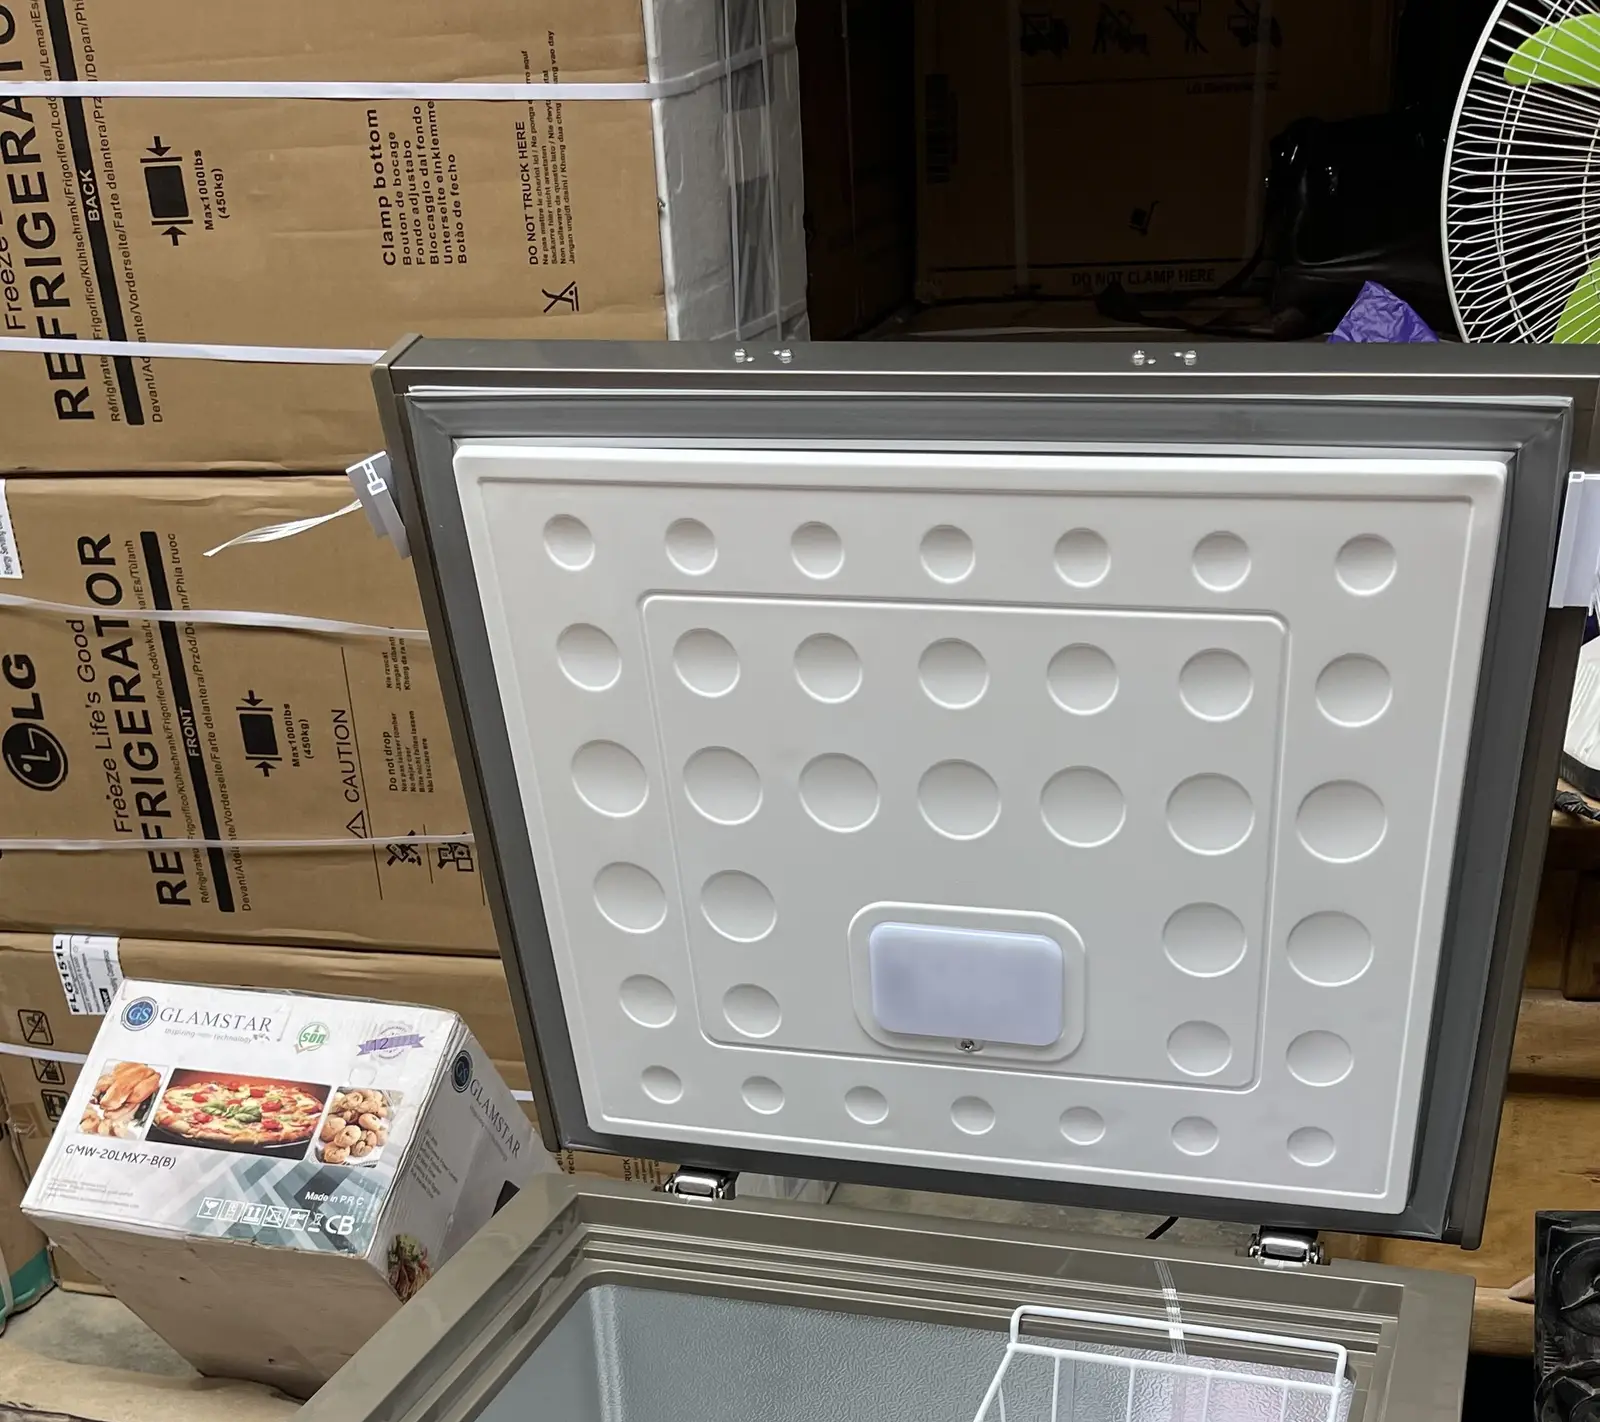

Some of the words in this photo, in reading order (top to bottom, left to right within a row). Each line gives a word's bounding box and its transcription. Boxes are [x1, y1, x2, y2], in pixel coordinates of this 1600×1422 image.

[366, 109, 387, 189] bottom
[411, 105, 425, 150] fondo
[515, 121, 529, 159] HERE
[387, 131, 402, 187] bocage
[403, 139, 420, 215] adjustabo
[417, 154, 429, 177] dal
[447, 154, 459, 197] fecho
[80, 169, 100, 222] BACK
[193, 149, 214, 231] Max1000lbs
[210, 168, 230, 219] (450kg)
[394, 191, 405, 208] de
[452, 201, 462, 218] de
[519, 163, 533, 210] TRUCK
[377, 196, 396, 266] Clamp
[398, 212, 412, 266] Bouton
[412, 219, 426, 265] Fondo
[421, 180, 439, 265] Bloccaggio
[437, 187, 453, 264] Unterseite
[525, 213, 537, 241] NOT
[528, 246, 539, 265] DO
[1071, 271, 1091, 287] DO
[1095, 271, 1123, 286] NOT
[1127, 269, 1174, 286] CLAMP
[1178, 268, 1215, 283] HERE
[65, 619, 96, 683] Good
[2, 654, 44, 720] LG
[77, 533, 192, 906] REFRIGERATOR
[85, 691, 113, 750] Life's
[180, 707, 201, 757] FRONT
[283, 703, 301, 767] Max1000lbs
[297, 718, 315, 760] (450kg)
[382, 731, 394, 756] drop
[331, 709, 360, 804] CAUTION
[385, 758, 395, 775] not
[103, 758, 133, 833] Freeze
[388, 777, 398, 792] Do
[55, 940, 80, 1012] FLG151L
[159, 1006, 272, 1032] GLAMSTAR
[469, 1078, 521, 1160] GLAMSTAR
[65, 1143, 177, 1169] GMW-20LMX7-B(B)
[623, 1158, 633, 1182] RUCK
[305, 1191, 329, 1202] Made
[329, 1195, 337, 1203] in
